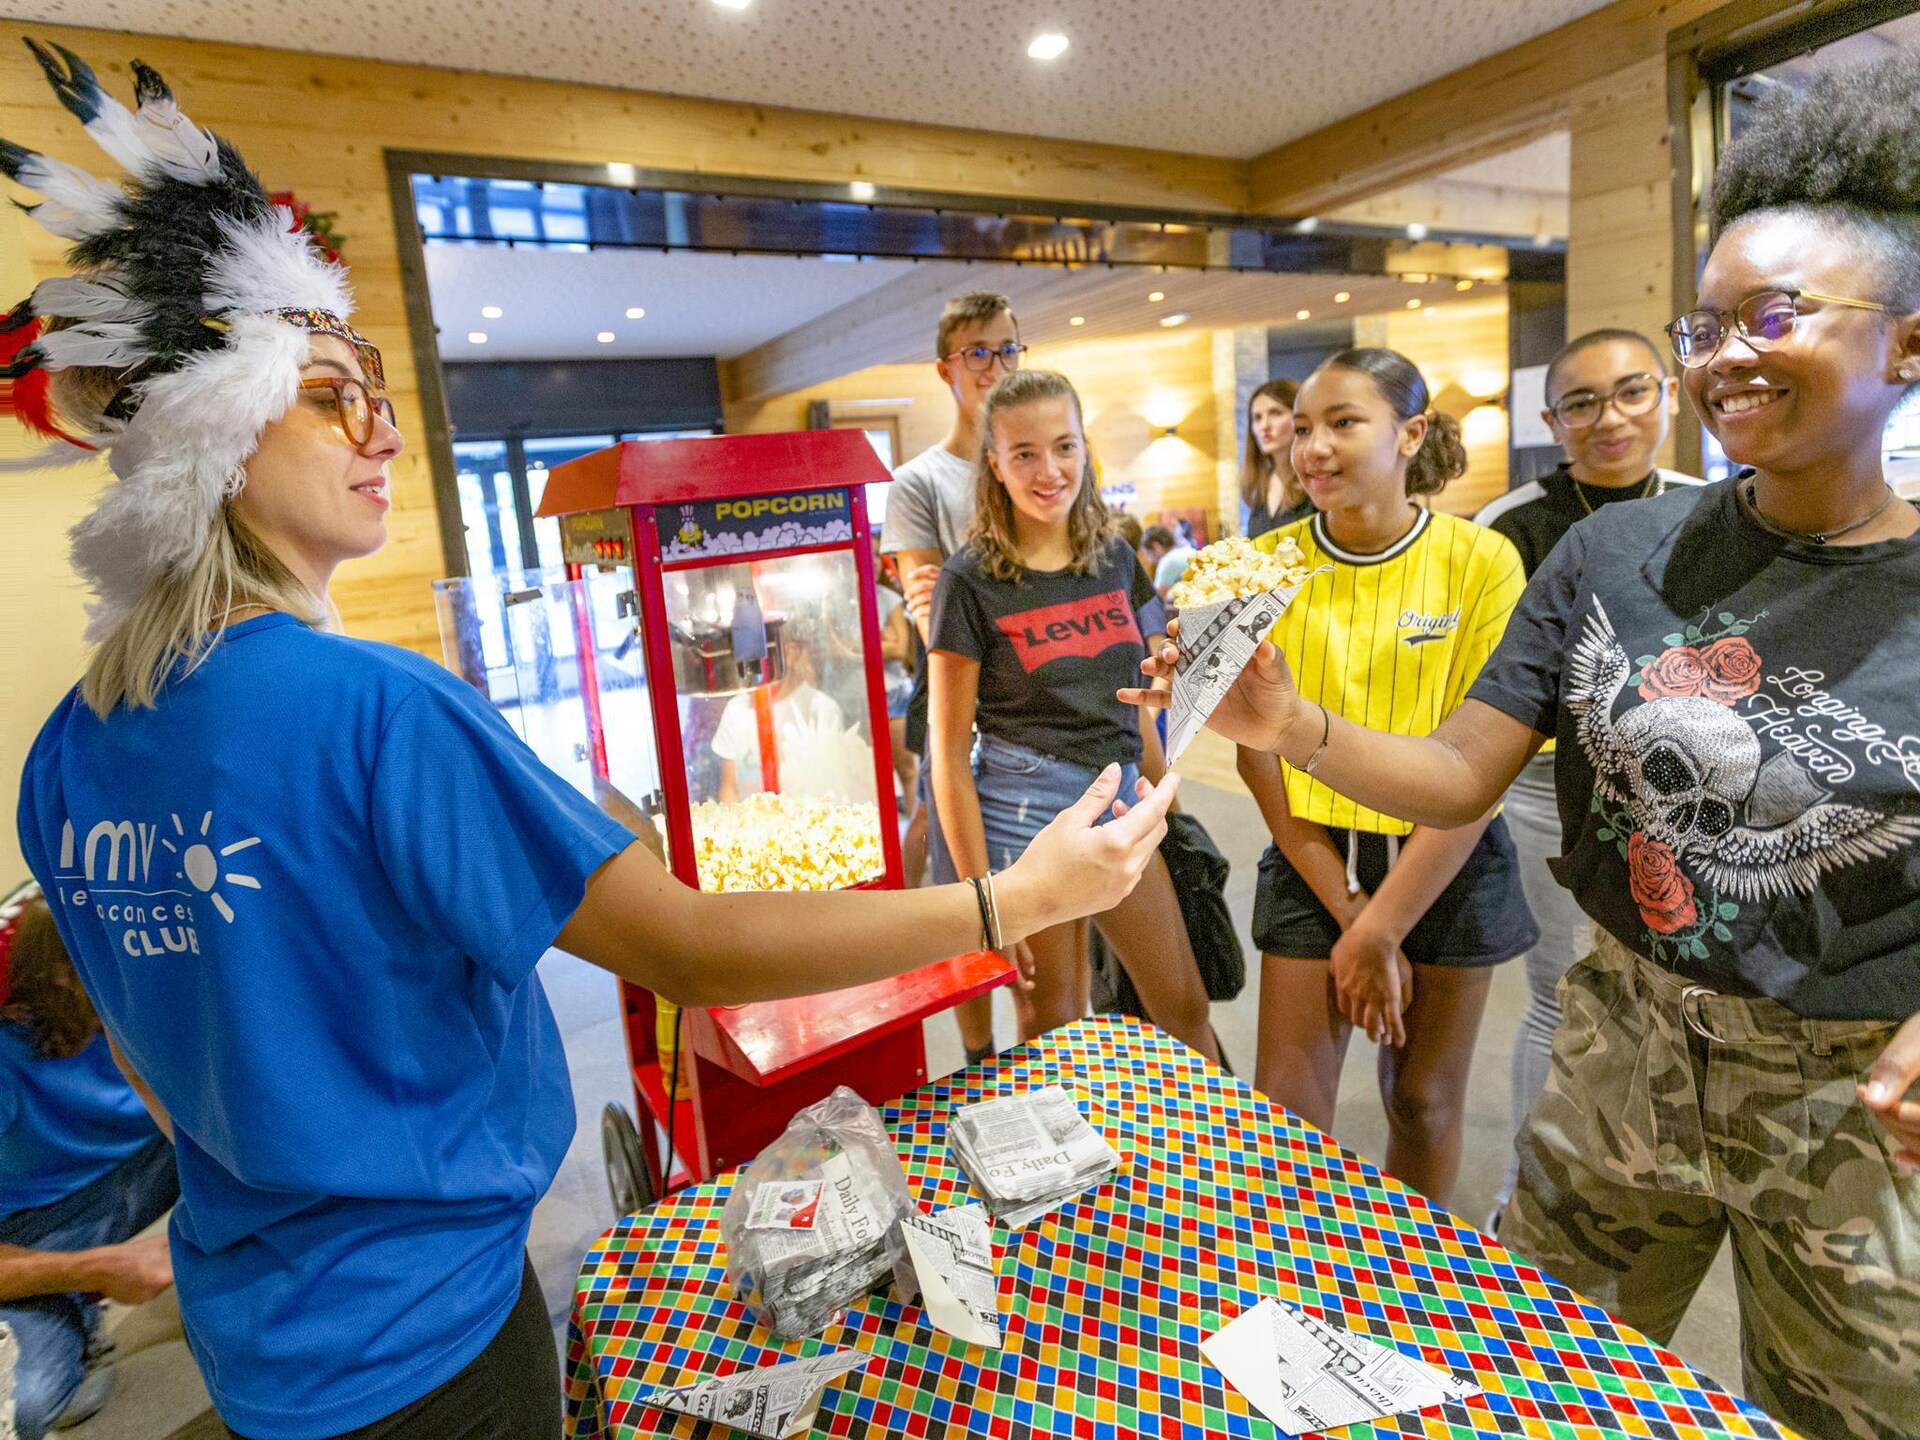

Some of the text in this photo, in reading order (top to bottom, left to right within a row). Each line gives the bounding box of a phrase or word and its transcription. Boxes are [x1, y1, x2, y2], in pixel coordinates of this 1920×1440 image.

[715, 492, 844, 521] POPCORN
[1766, 667, 1886, 742] Longing
[1021, 1150, 1072, 1172] Daily
[834, 1175, 870, 1240] Daily Fo
